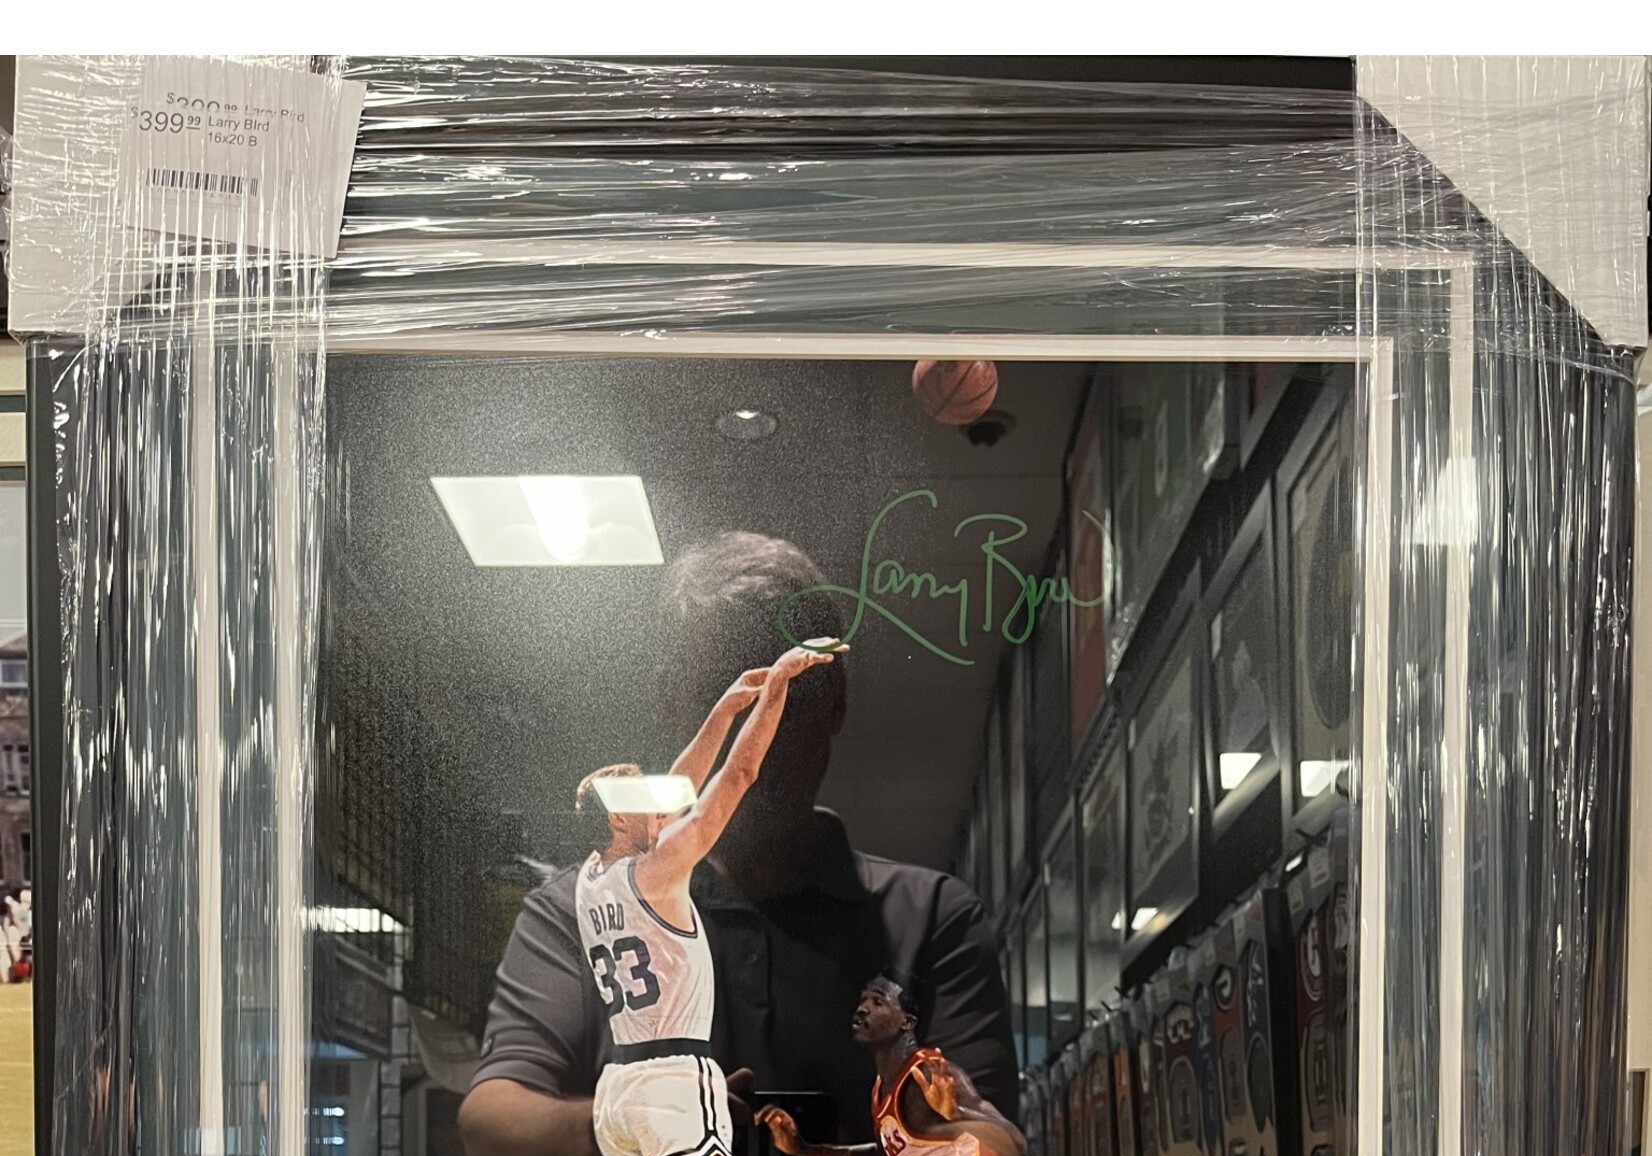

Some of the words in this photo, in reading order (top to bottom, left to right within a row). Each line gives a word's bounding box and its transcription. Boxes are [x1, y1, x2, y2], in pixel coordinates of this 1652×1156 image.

[208, 115, 240, 131] Larry
[208, 132, 245, 146] 16x20
[248, 135, 258, 147] B
[777, 489, 975, 666] Larry
[588, 903, 625, 936] BIRD
[588, 935, 661, 1017] 33
